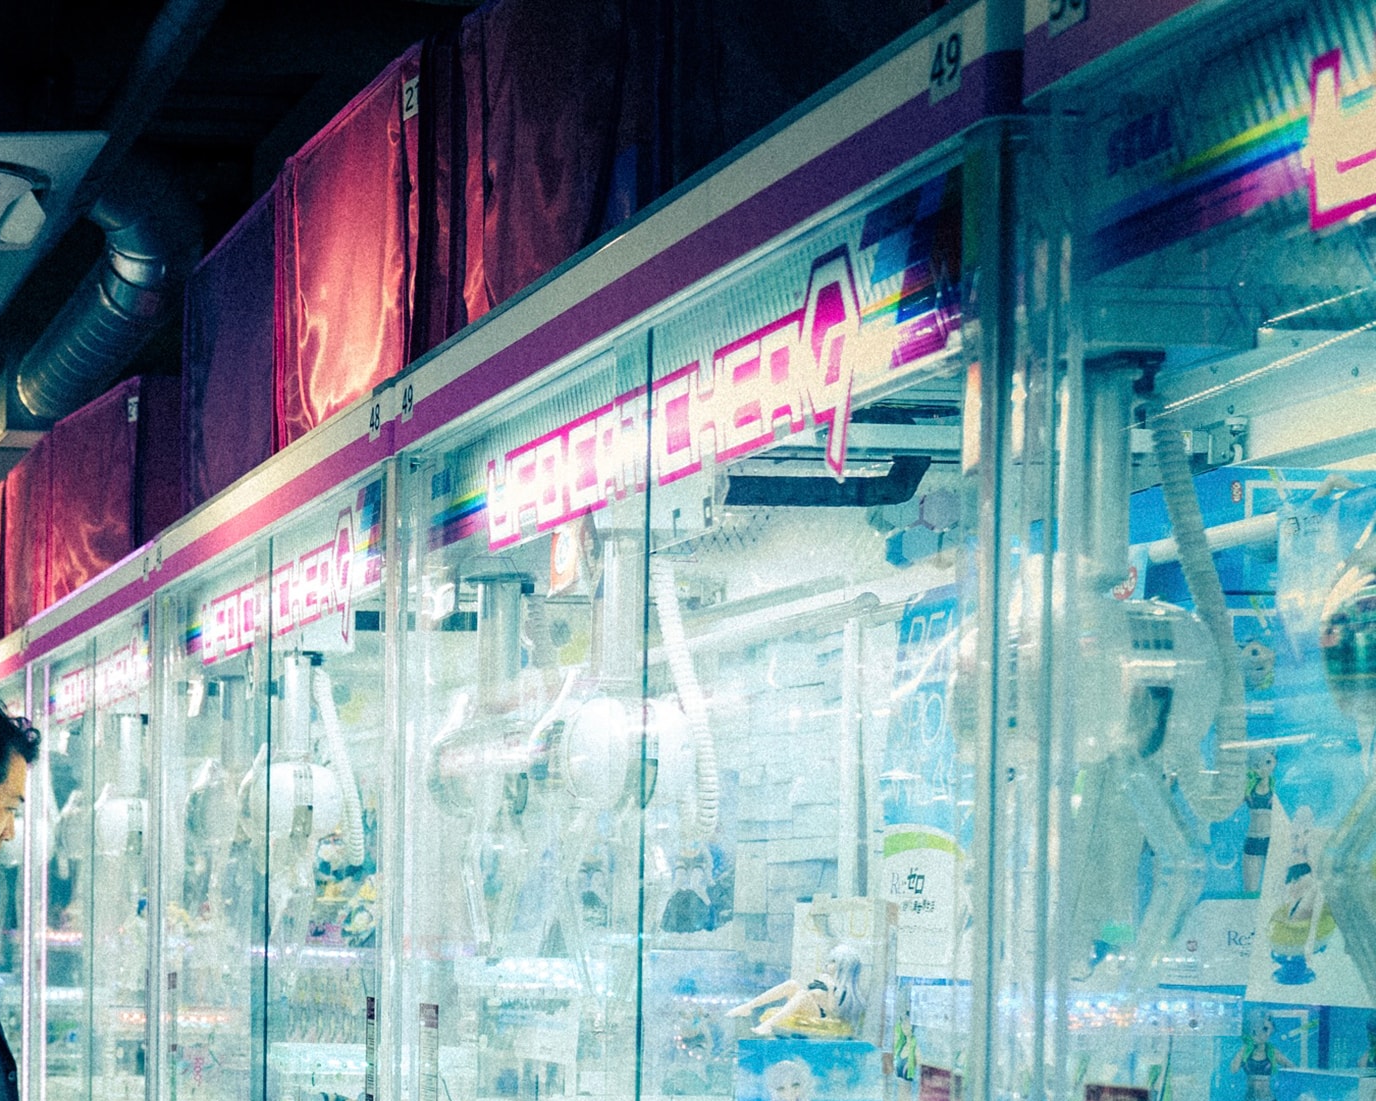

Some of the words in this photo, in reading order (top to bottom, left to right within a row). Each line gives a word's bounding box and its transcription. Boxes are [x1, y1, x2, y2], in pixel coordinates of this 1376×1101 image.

[930, 32, 961, 87] 49
[405, 81, 419, 112] 2
[401, 383, 414, 415] 49
[369, 403, 381, 432] 48
